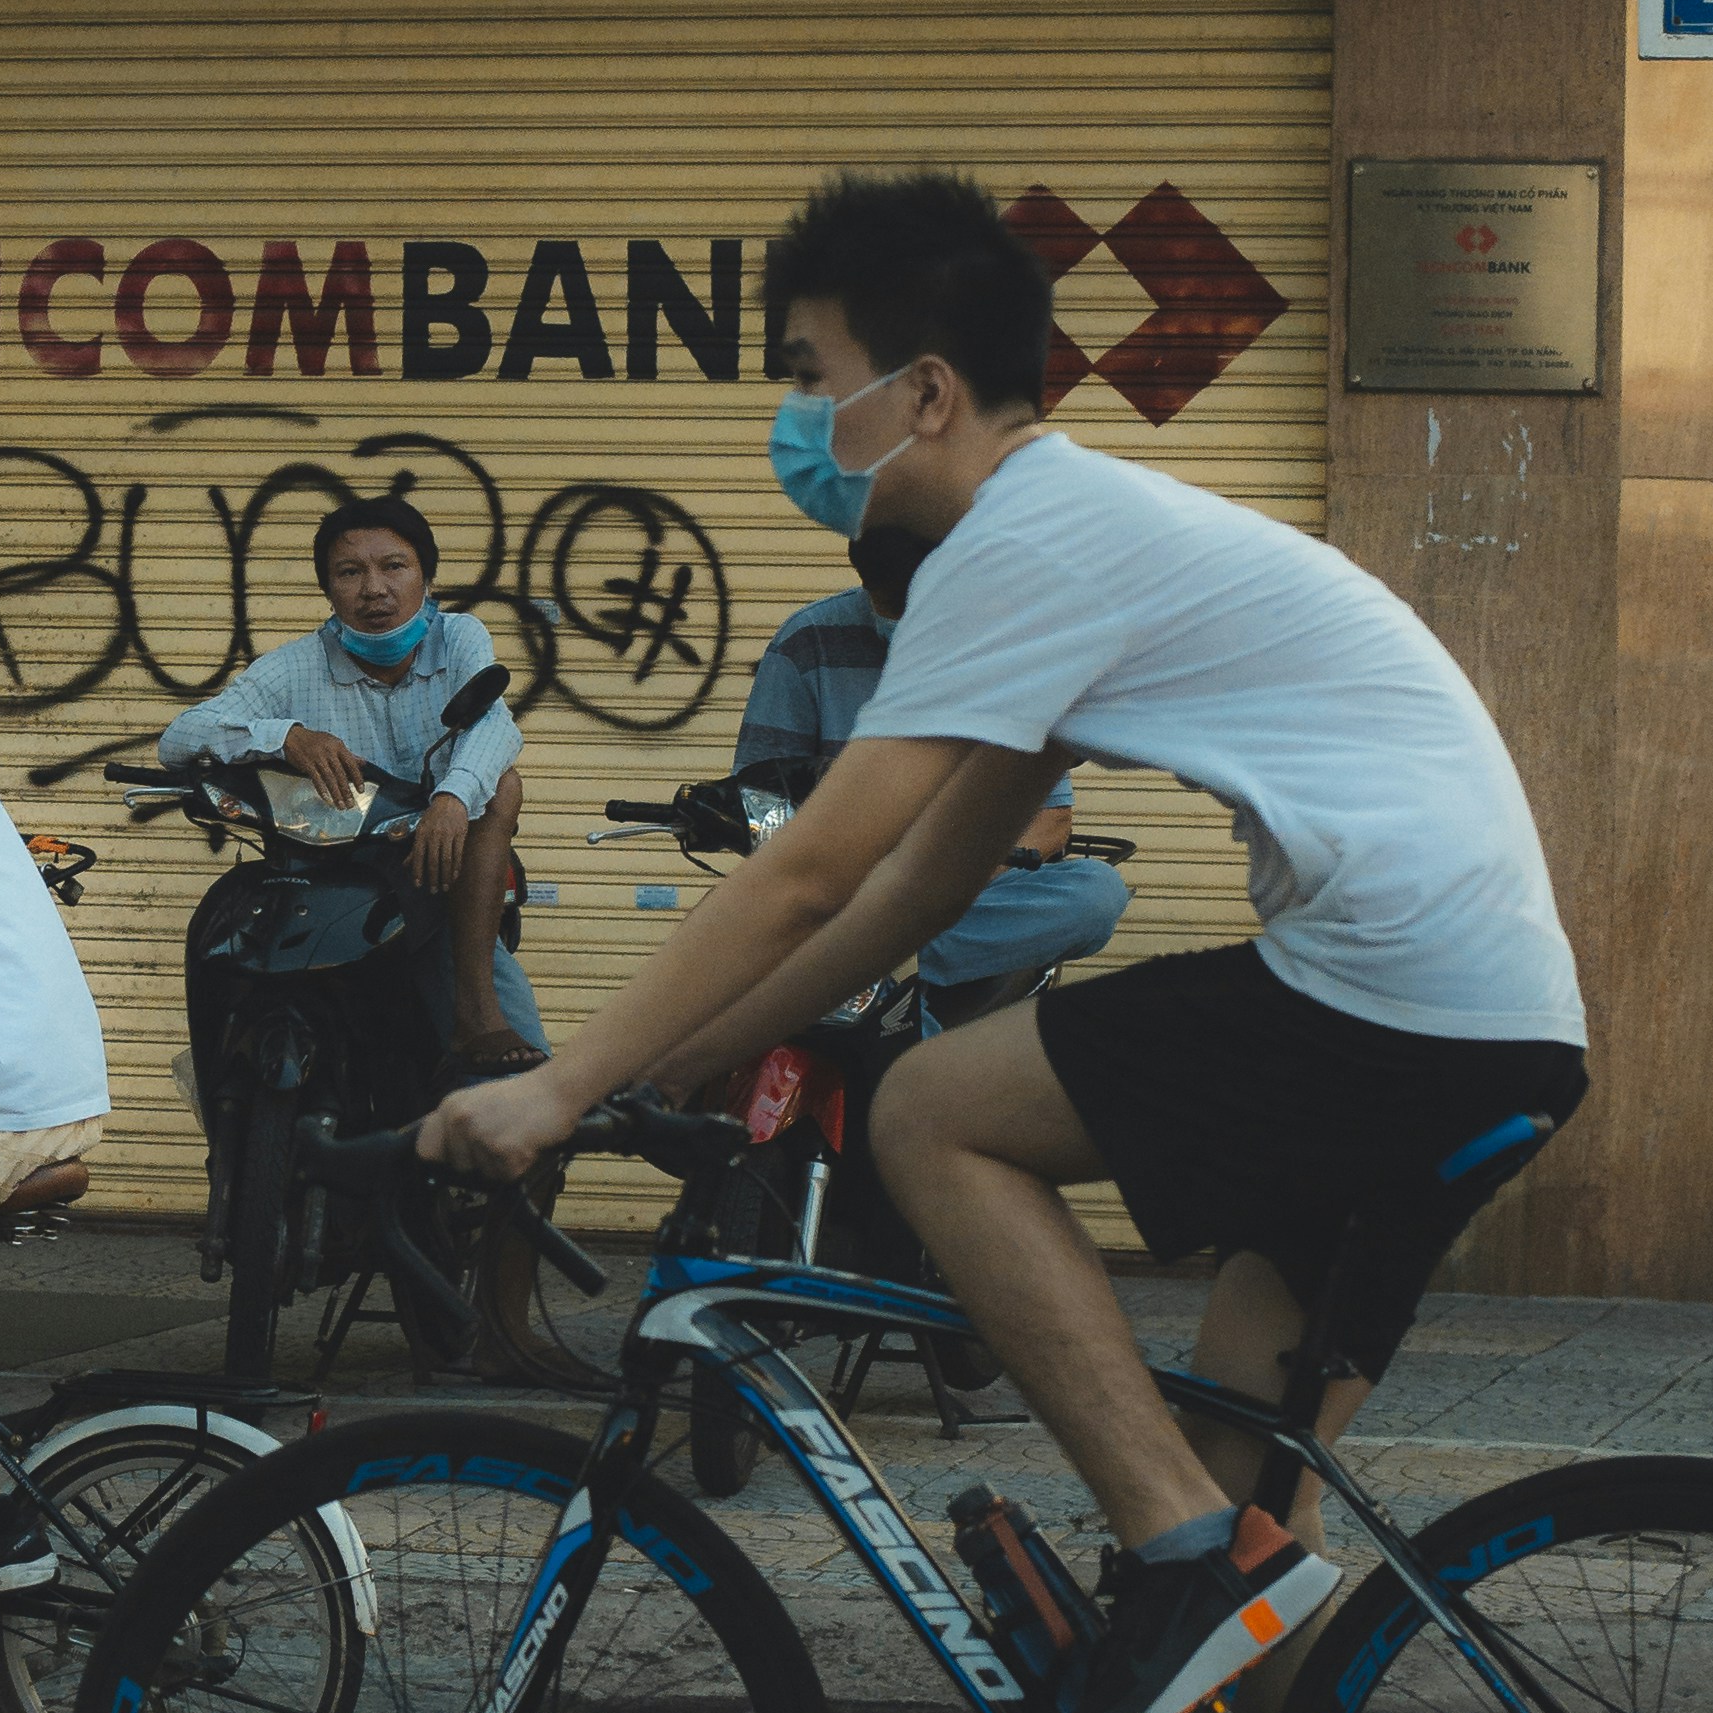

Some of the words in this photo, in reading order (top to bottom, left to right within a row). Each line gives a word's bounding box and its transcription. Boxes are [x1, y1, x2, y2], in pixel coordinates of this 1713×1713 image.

[261, 877, 312, 886] HONDA
[879, 1021, 914, 1038] HONDA
[774, 1407, 1026, 1702] FASCINO
